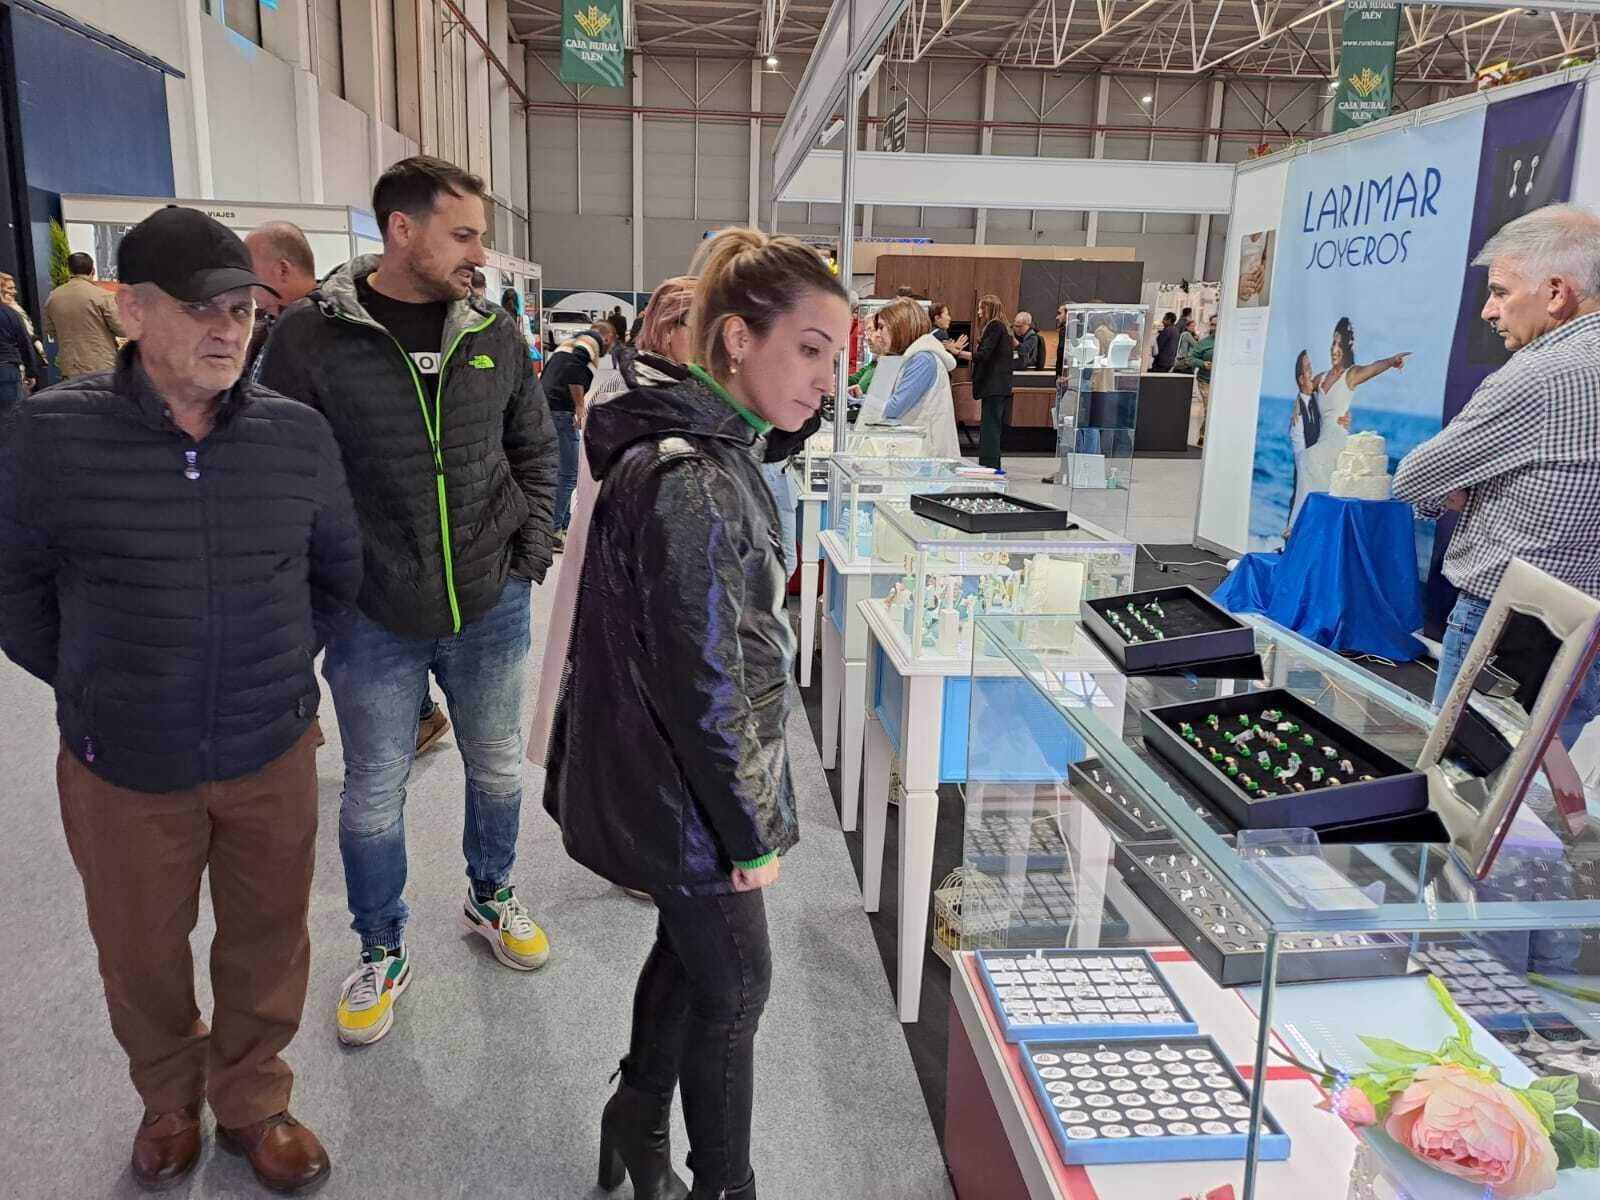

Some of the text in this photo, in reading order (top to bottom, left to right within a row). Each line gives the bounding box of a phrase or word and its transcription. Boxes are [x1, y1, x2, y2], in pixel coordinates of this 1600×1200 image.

[564, 39, 620, 52] CAJA RURAL
[1303, 168, 1441, 233] LARIMAR
[207, 210, 236, 218] VIAJES
[1306, 230, 1412, 270] JOYEROS
